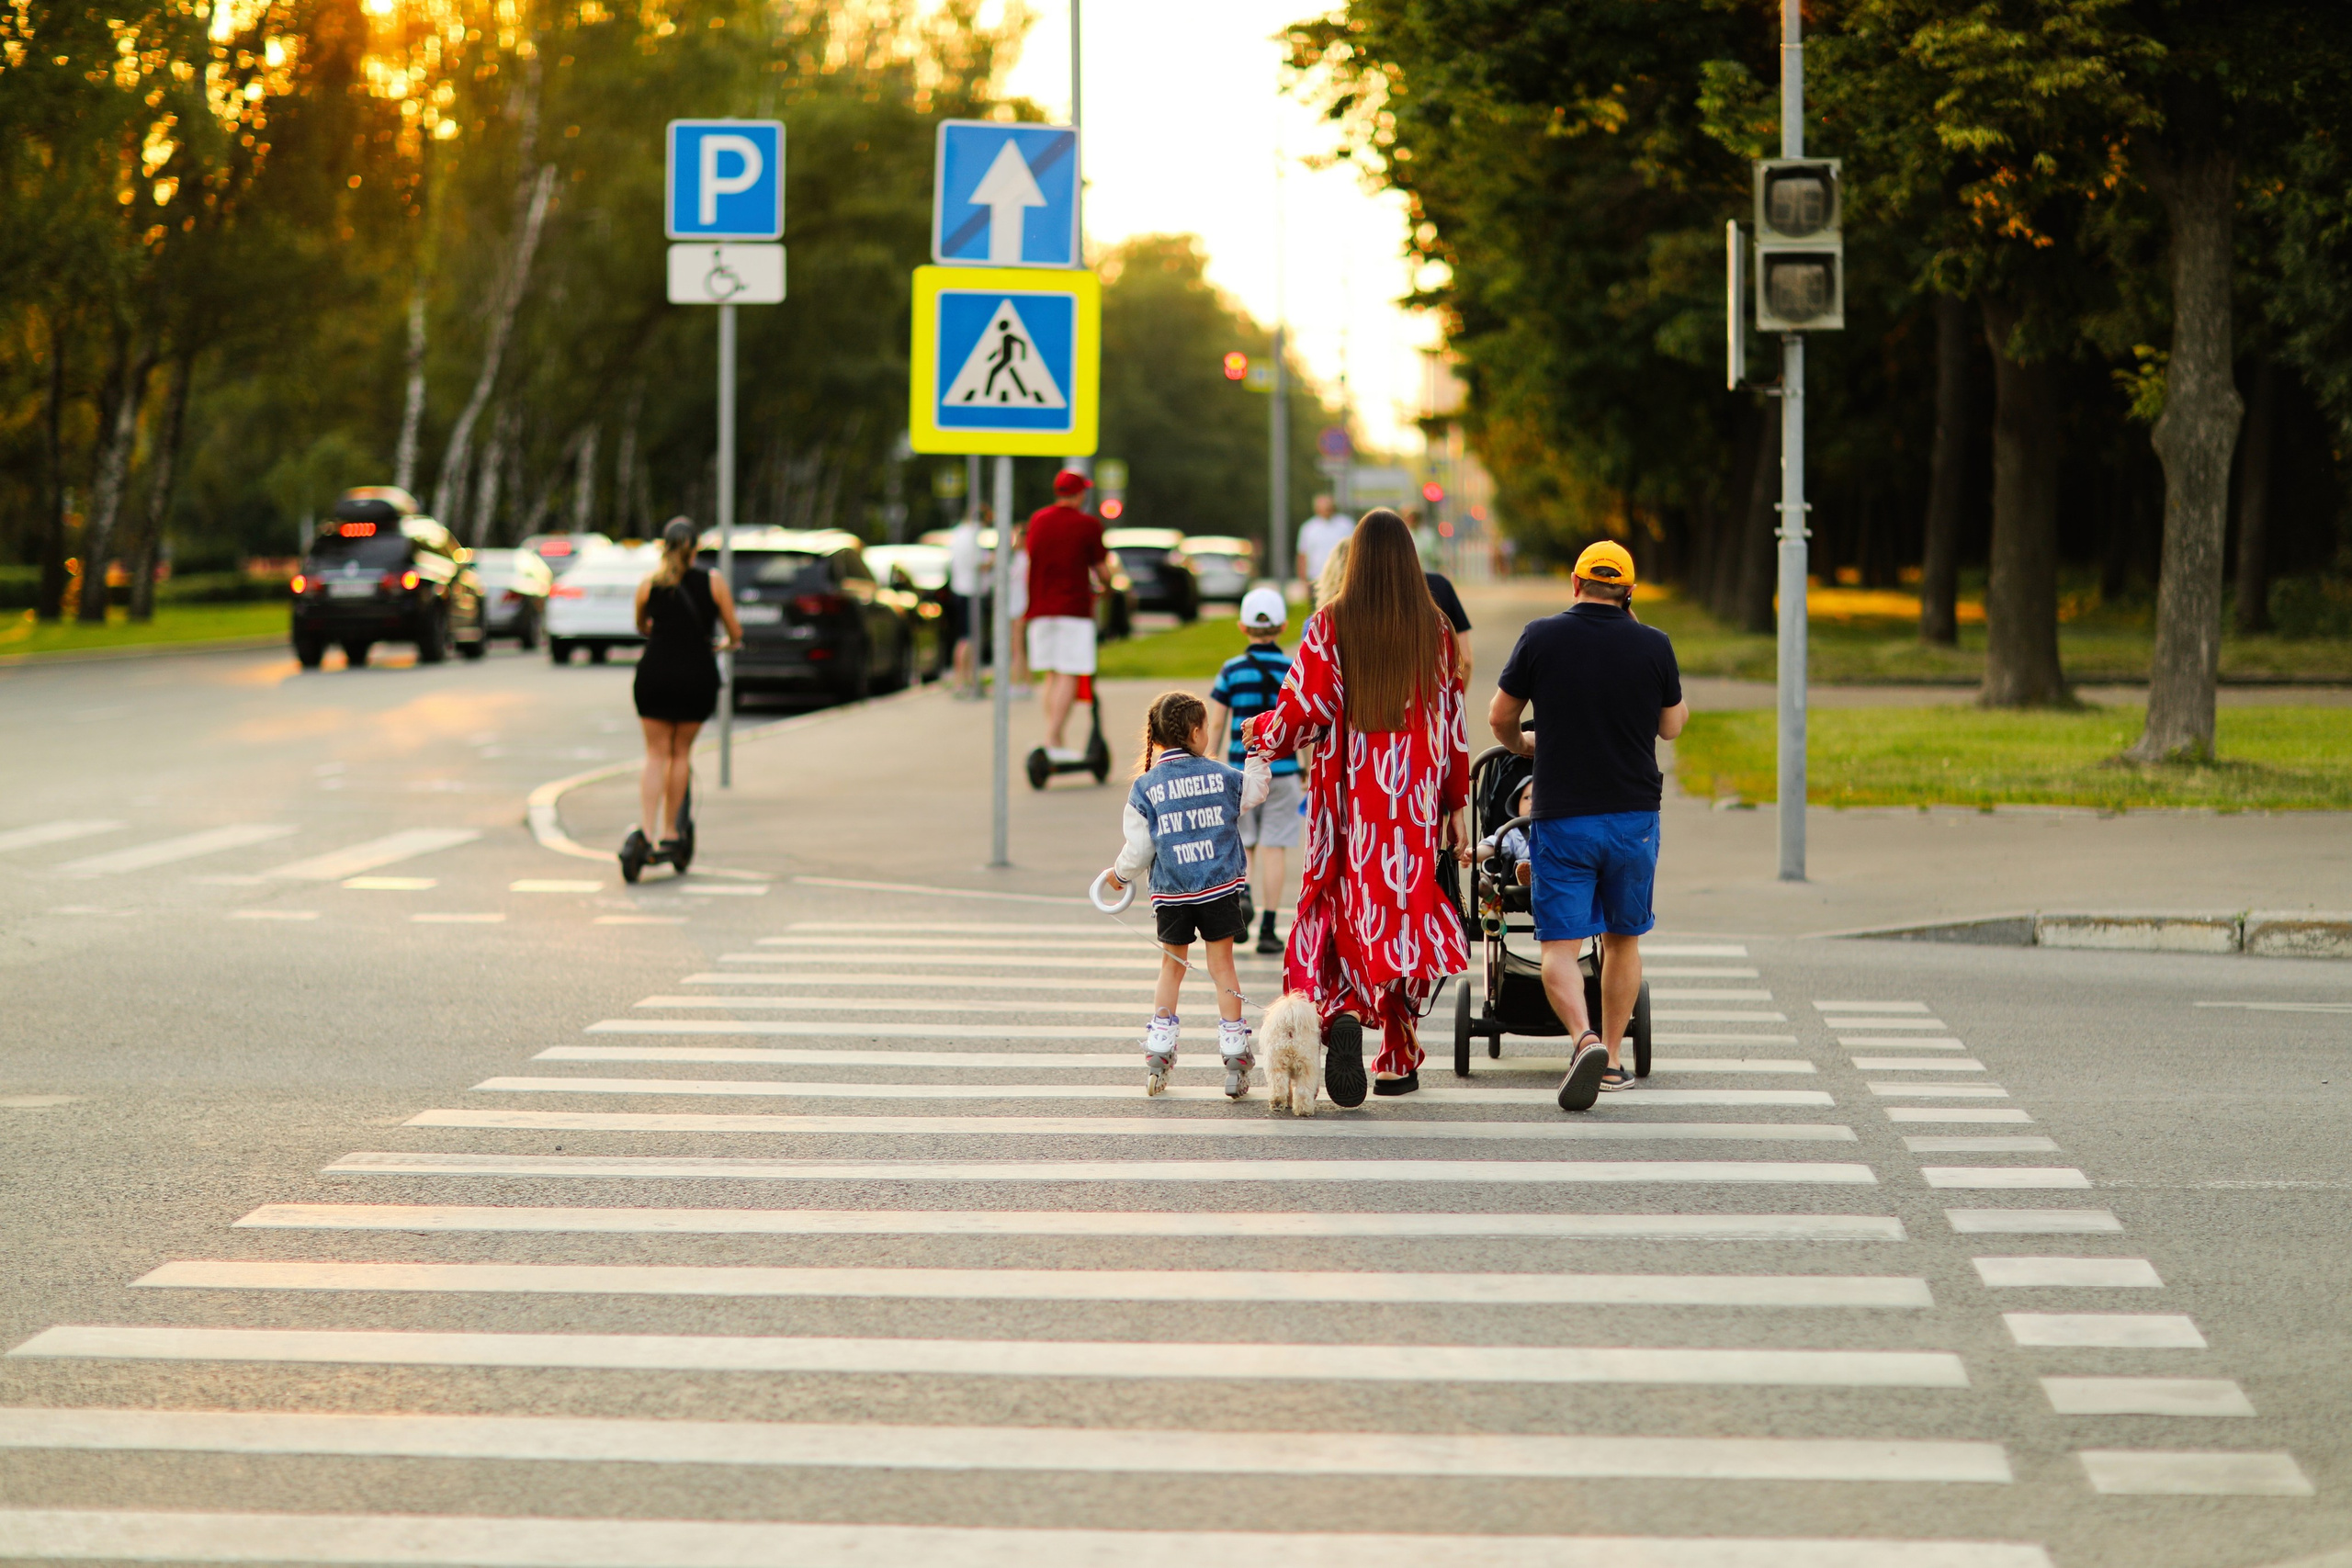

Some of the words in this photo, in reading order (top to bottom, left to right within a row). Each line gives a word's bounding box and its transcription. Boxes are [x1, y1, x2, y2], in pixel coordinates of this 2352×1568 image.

[699, 134, 763, 226] P
[1168, 773, 1225, 800] ANGELES
[1186, 806, 1225, 829] YORK
[1172, 840, 1215, 864] TOKYO
